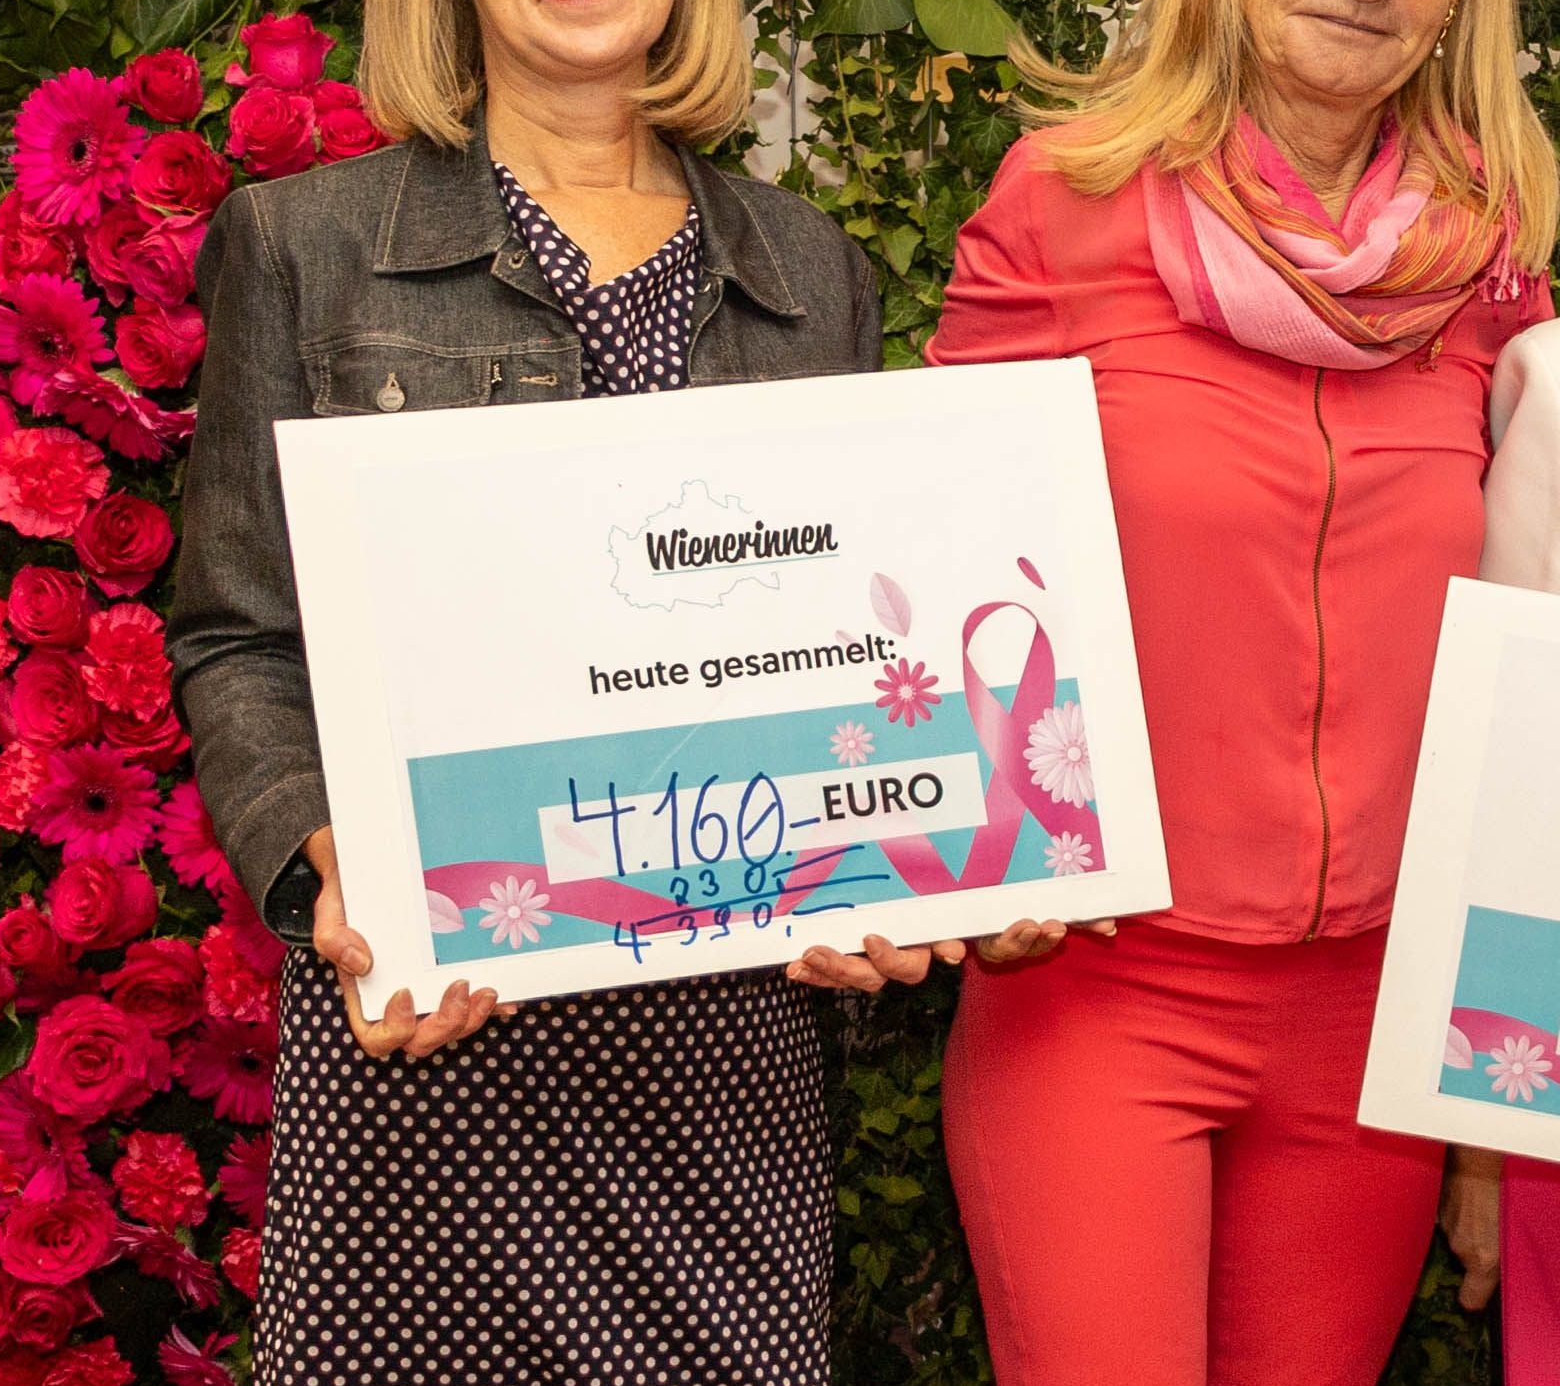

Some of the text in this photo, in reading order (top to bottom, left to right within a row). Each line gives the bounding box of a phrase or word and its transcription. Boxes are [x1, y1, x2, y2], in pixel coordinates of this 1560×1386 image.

[646, 521, 838, 570] Wienerinnen
[589, 633, 897, 694] heute gesammelt:
[823, 774, 943, 820] EURO
